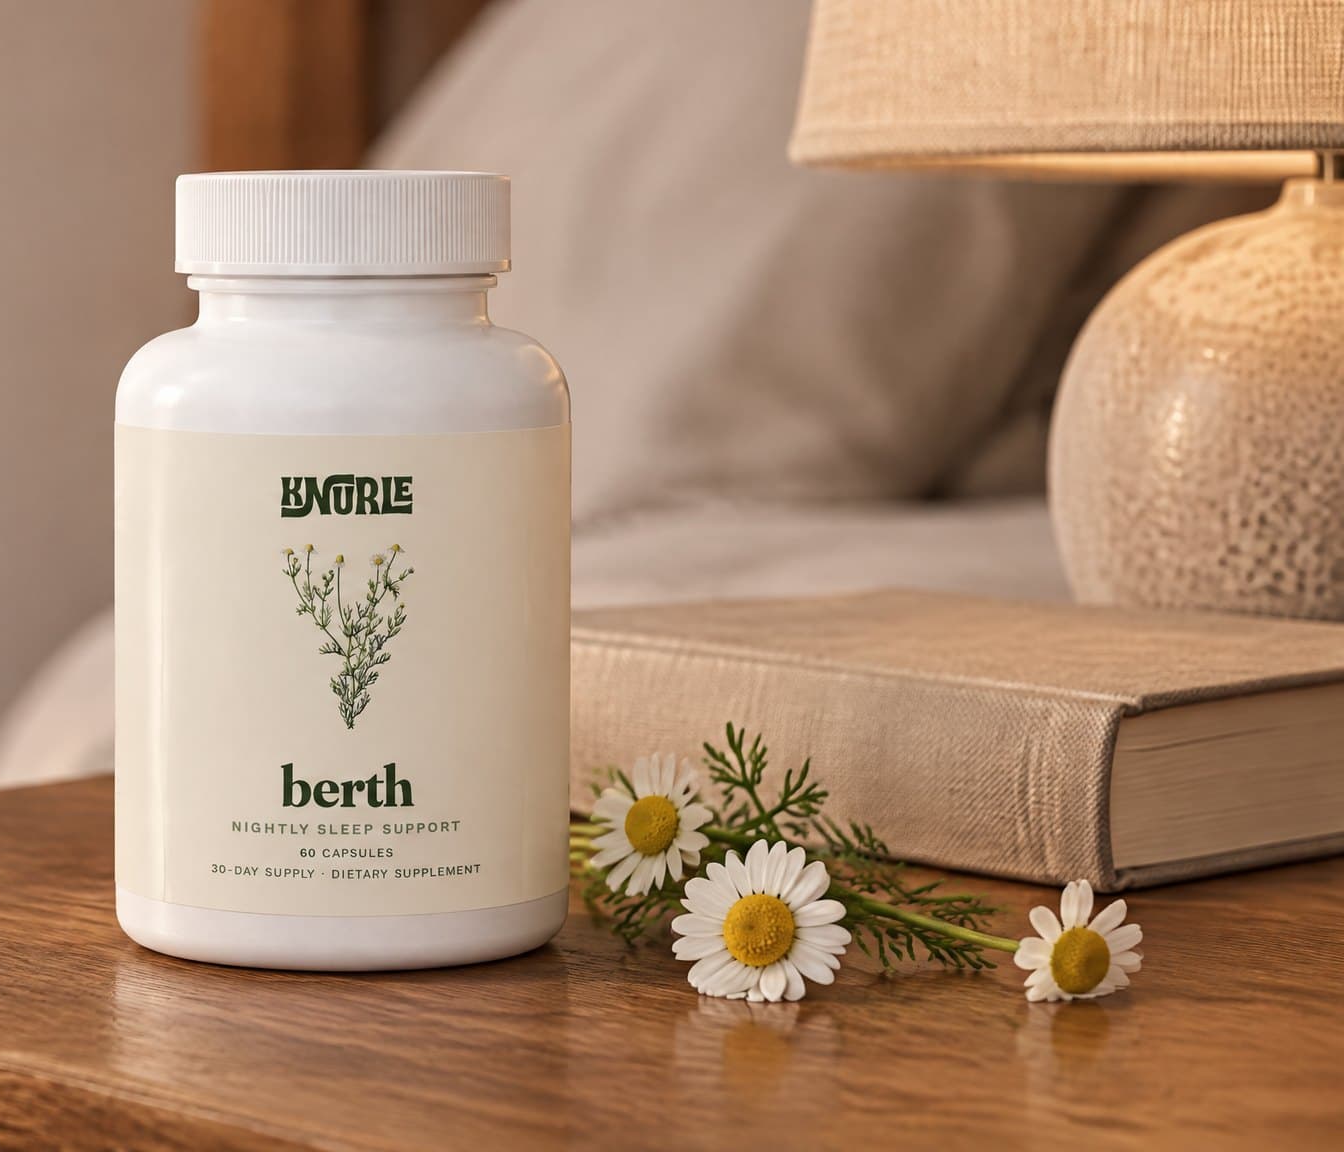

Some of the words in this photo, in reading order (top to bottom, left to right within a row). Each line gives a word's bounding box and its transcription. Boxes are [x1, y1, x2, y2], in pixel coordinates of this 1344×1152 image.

[280, 473, 414, 519] KNURLE
[280, 762, 416, 809] berth
[231, 820, 309, 836] NIGHTLY
[316, 823, 374, 836] SLEEP
[382, 819, 461, 836] SUPPORT
[299, 847, 316, 859] 60
[321, 847, 394, 859] CAPSULES
[210, 863, 260, 877] 30-DAY
[263, 866, 316, 879] SUPPLY
[331, 868, 389, 880] DIETARY
[394, 863, 481, 879] SUPPLEMENT
